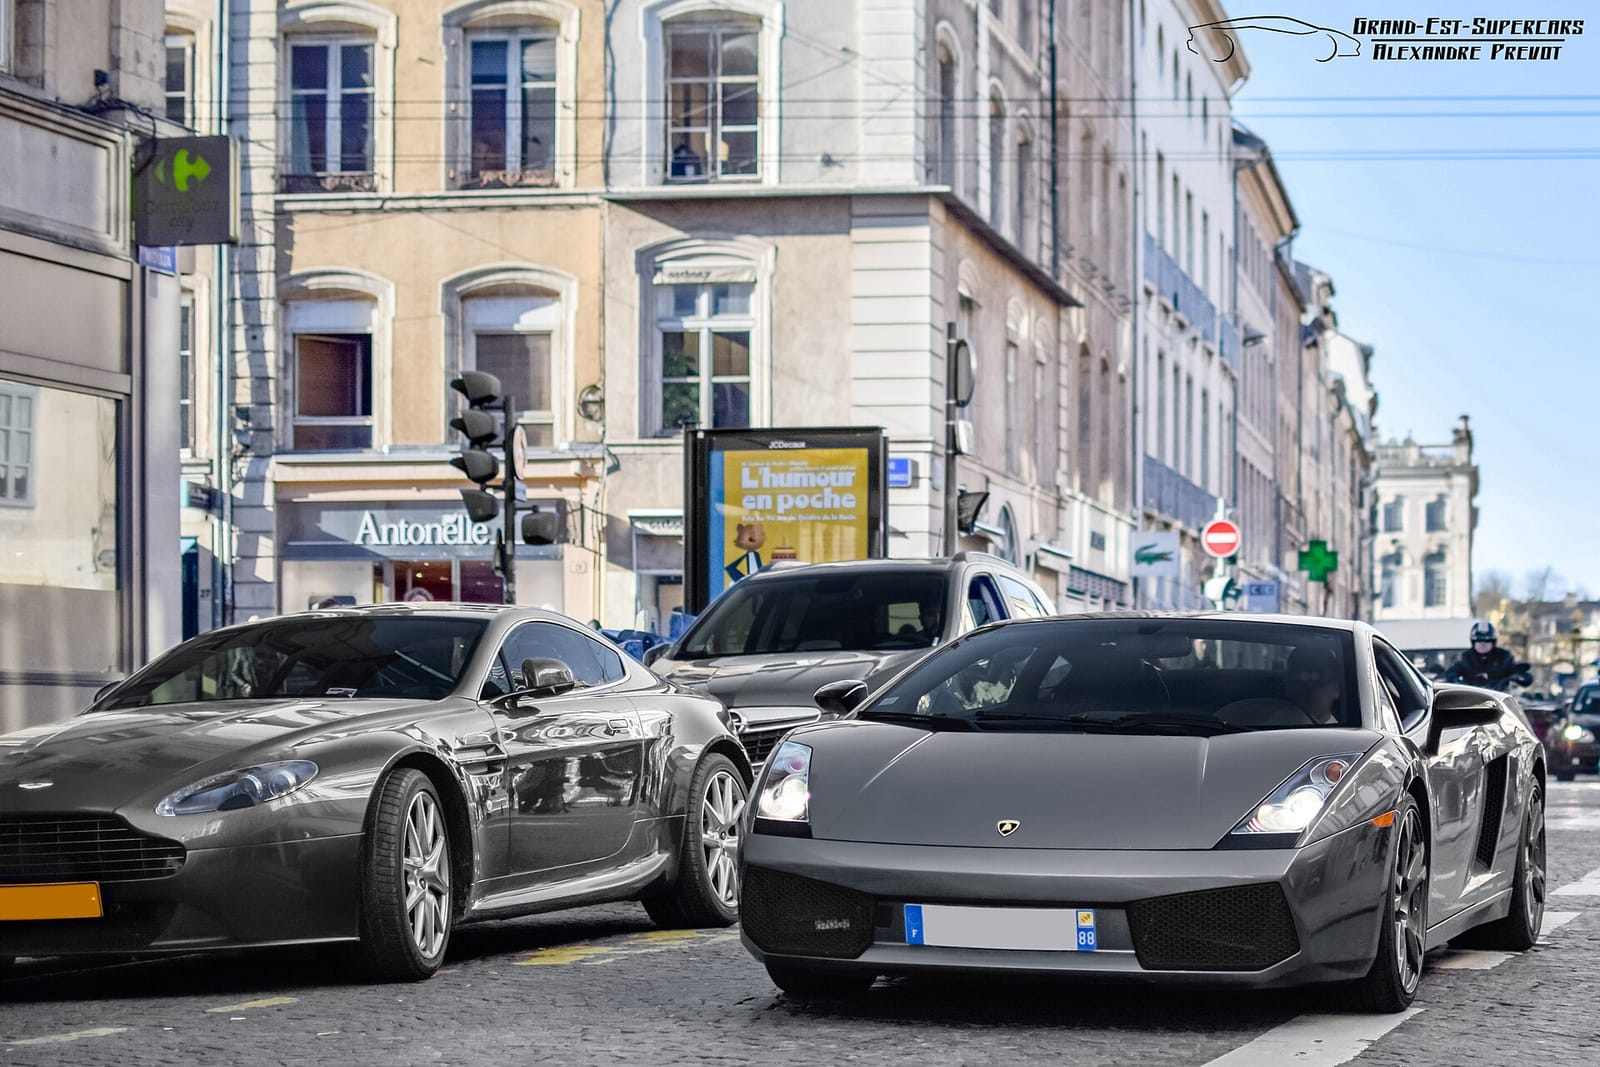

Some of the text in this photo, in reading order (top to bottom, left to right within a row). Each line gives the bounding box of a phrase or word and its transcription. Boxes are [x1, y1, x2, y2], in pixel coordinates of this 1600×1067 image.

[741, 467, 856, 488] L'humour
[741, 487, 857, 514] en poche
[912, 929, 918, 938] F
[1078, 931, 1095, 945] 88
